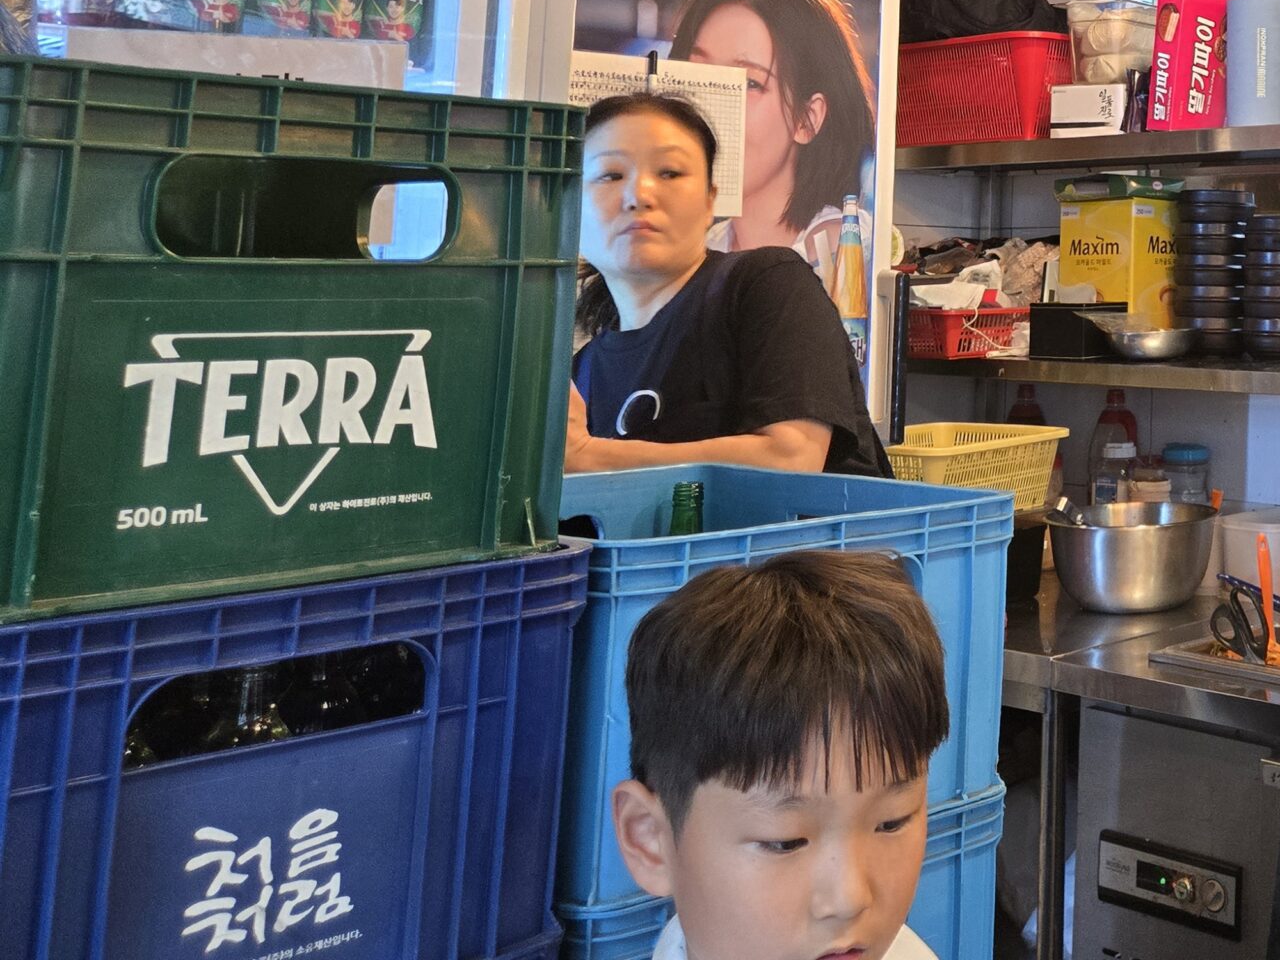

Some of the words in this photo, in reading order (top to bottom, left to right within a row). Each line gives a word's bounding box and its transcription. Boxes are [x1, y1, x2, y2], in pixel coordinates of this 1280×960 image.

[1153, 52, 1171, 121] 딸기파이
[1188, 16, 1216, 115] 딸기파이
[1069, 235, 1120, 256] Maxim
[1147, 235, 1179, 256] Max
[123, 354, 438, 468] TERRA
[116, 506, 165, 530] 500
[171, 503, 209, 527] mL
[184, 807, 342, 898] 처음
[181, 873, 354, 953] 처럼
